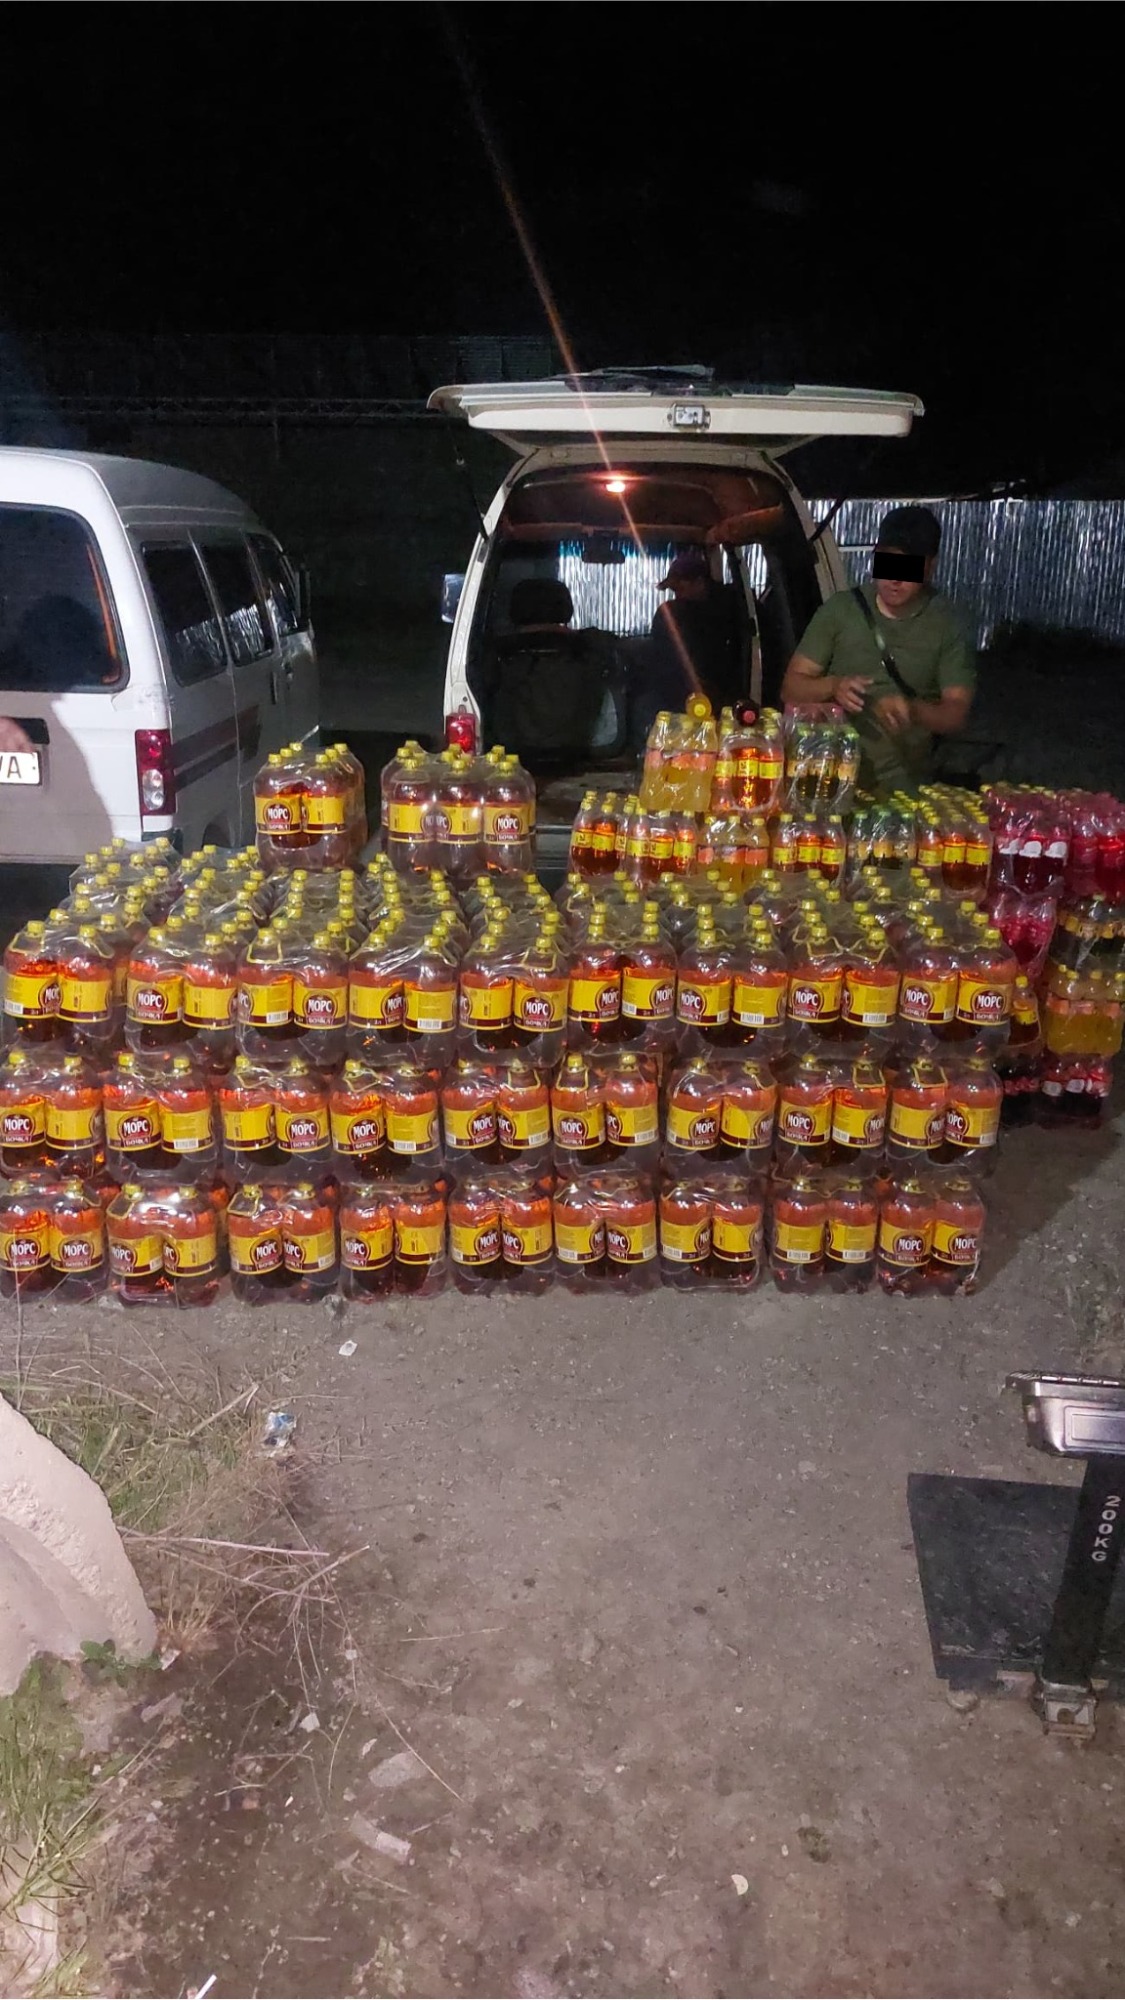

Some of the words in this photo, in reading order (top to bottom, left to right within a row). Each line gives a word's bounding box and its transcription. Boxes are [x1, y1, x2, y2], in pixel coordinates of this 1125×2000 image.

[0, 756, 21, 778] A
[268, 808, 288, 820] МОРС
[497, 817, 518, 829] МОРС
[138, 993, 162, 1007] МОРС
[795, 991, 818, 1006] МОРС
[906, 989, 928, 1005] МОРС
[977, 995, 1001, 1009] МОРС
[308, 1000, 332, 1013] МОРС
[526, 1002, 549, 1015] МОРС
[4, 1118, 29, 1132] МОРС
[123, 1120, 148, 1135] МОРС
[473, 1115, 493, 1132] МОРС
[561, 1121, 582, 1133] МОРС
[695, 1121, 716, 1136] МОРС
[787, 1115, 810, 1130] МОРС
[291, 1123, 315, 1137] МОРС
[353, 1123, 376, 1138] МОРС
[11, 1242, 35, 1256] МОРС
[64, 1242, 89, 1256] МОРС
[256, 1242, 277, 1260] МОРС
[899, 1239, 921, 1252] МОРС
